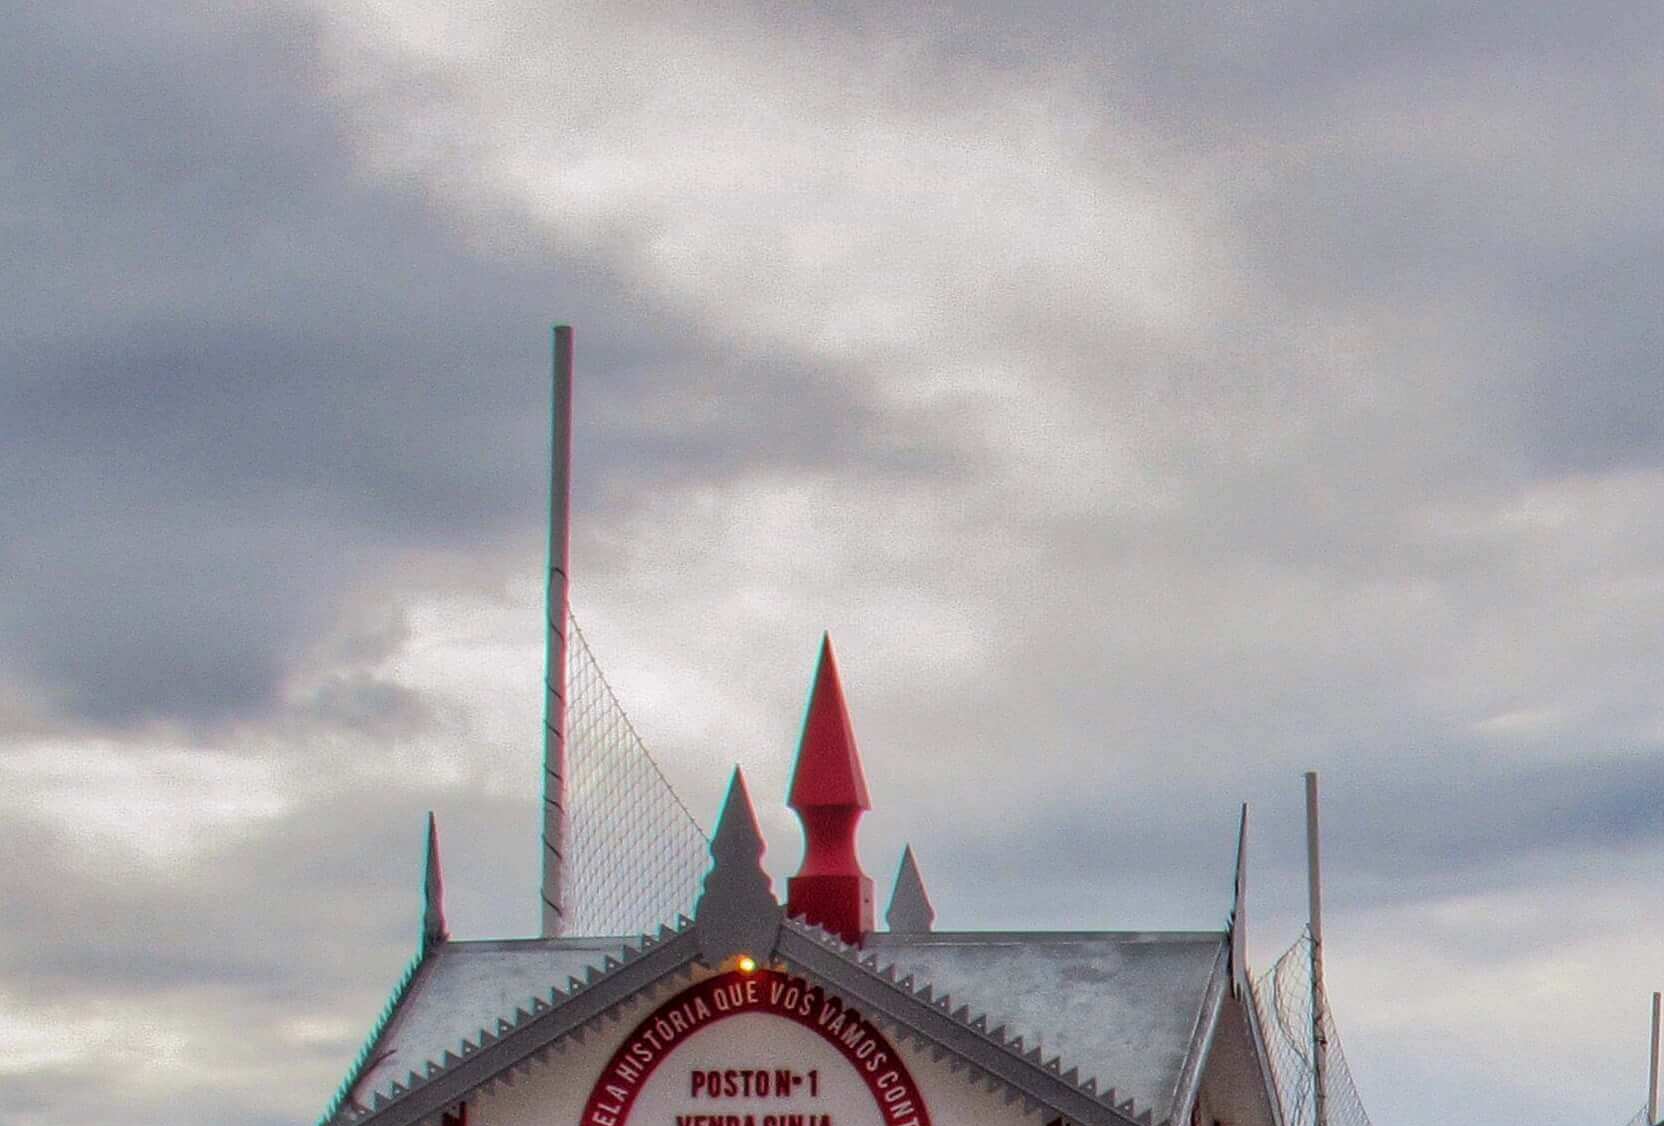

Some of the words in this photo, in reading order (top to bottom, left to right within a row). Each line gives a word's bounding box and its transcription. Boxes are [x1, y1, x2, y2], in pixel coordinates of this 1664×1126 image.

[615, 997, 712, 1085] HISTÓRIA
[713, 980, 759, 1012] QUE
[770, 981, 815, 1016] VOS
[818, 1003, 888, 1072] VAMOS
[690, 1069, 770, 1098] POSTO
[808, 1069, 819, 1098] 1
